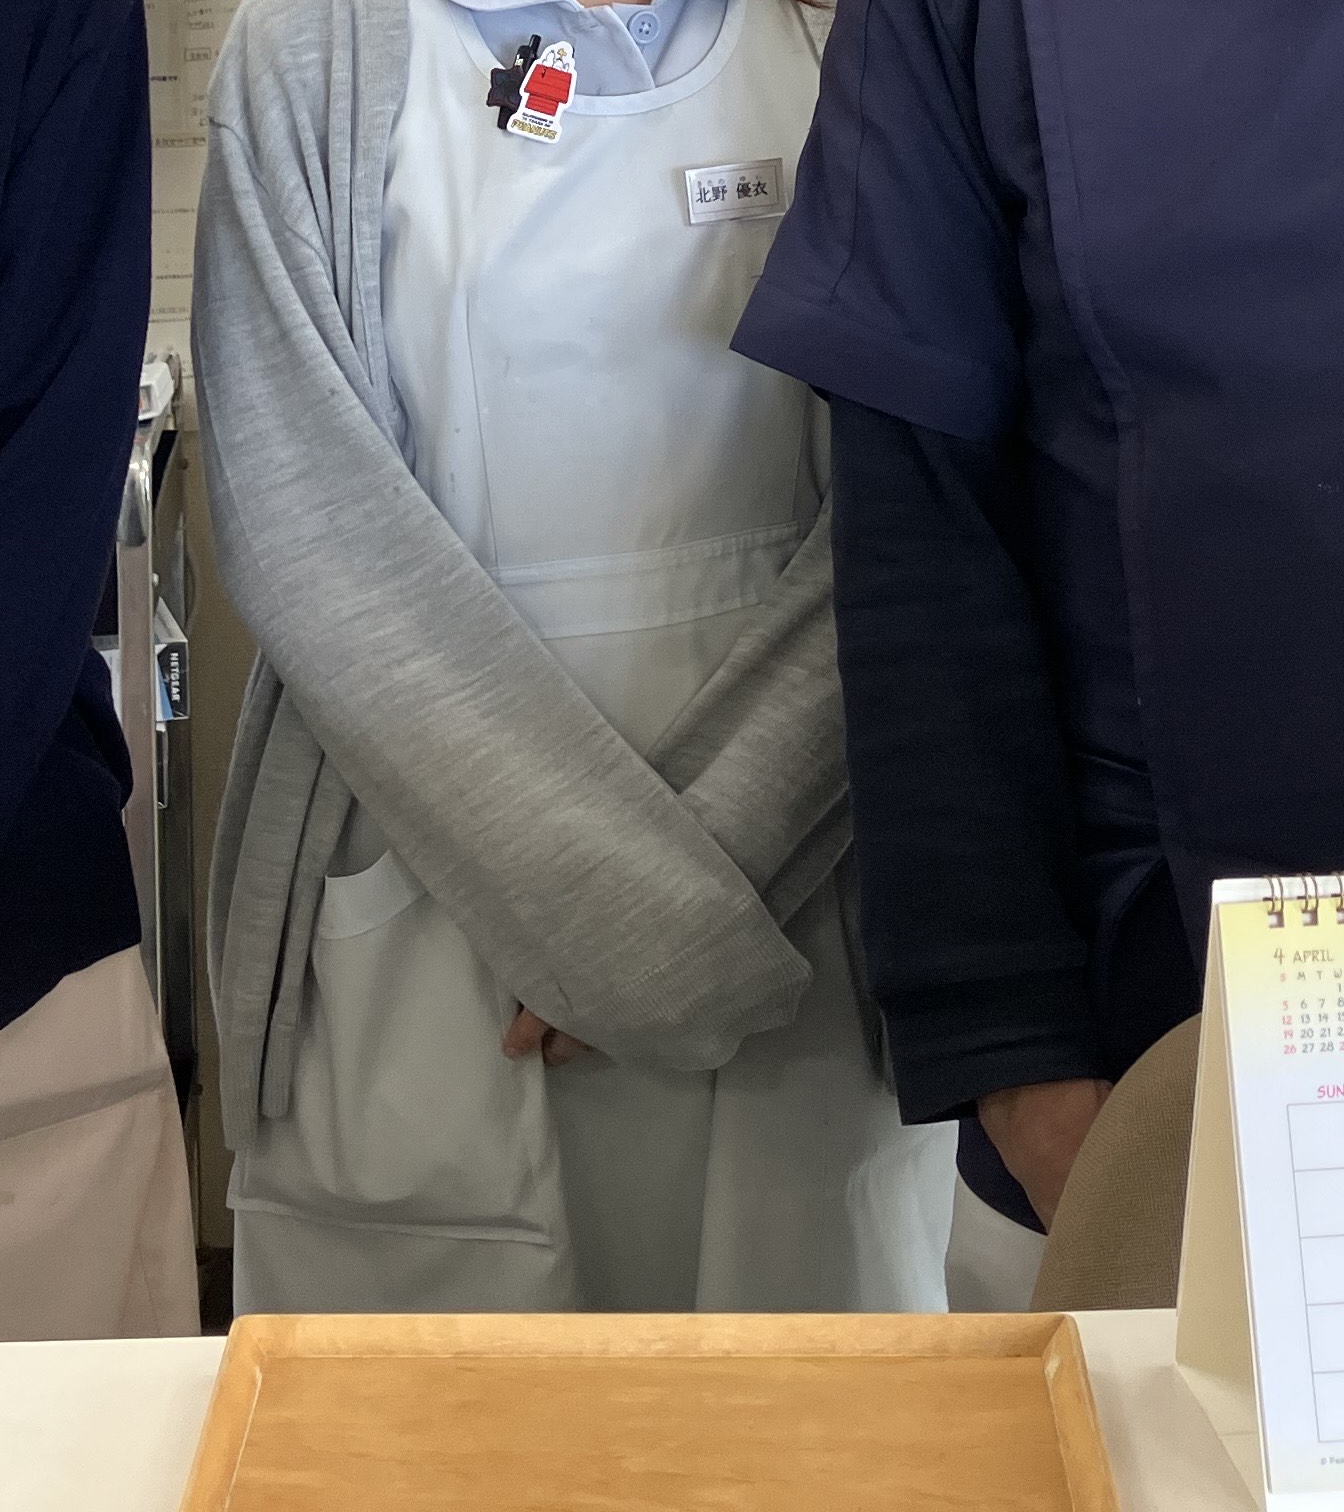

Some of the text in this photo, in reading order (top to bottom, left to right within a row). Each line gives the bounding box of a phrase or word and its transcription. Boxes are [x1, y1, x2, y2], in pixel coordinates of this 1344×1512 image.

[169, 652, 181, 703] NETGEAR
[1273, 948, 1334, 965] 4 APRIL
[1334, 969, 1342, 979] W
[1282, 1000, 1289, 1011] 5
[1300, 999, 1307, 1009] 6
[1319, 998, 1325, 1009] 7
[1337, 997, 1344, 1007] 8
[1282, 1016, 1292, 1025] 12
[1300, 1014, 1310, 1024] 13
[1318, 1013, 1328, 1023] 14
[1283, 1029, 1294, 1039] 19
[1300, 1028, 1314, 1039] 20
[1320, 1028, 1331, 1038] 21
[1283, 1044, 1297, 1054] 26
[1302, 1043, 1314, 1053] 27
[1320, 1041, 1334, 1052] 28
